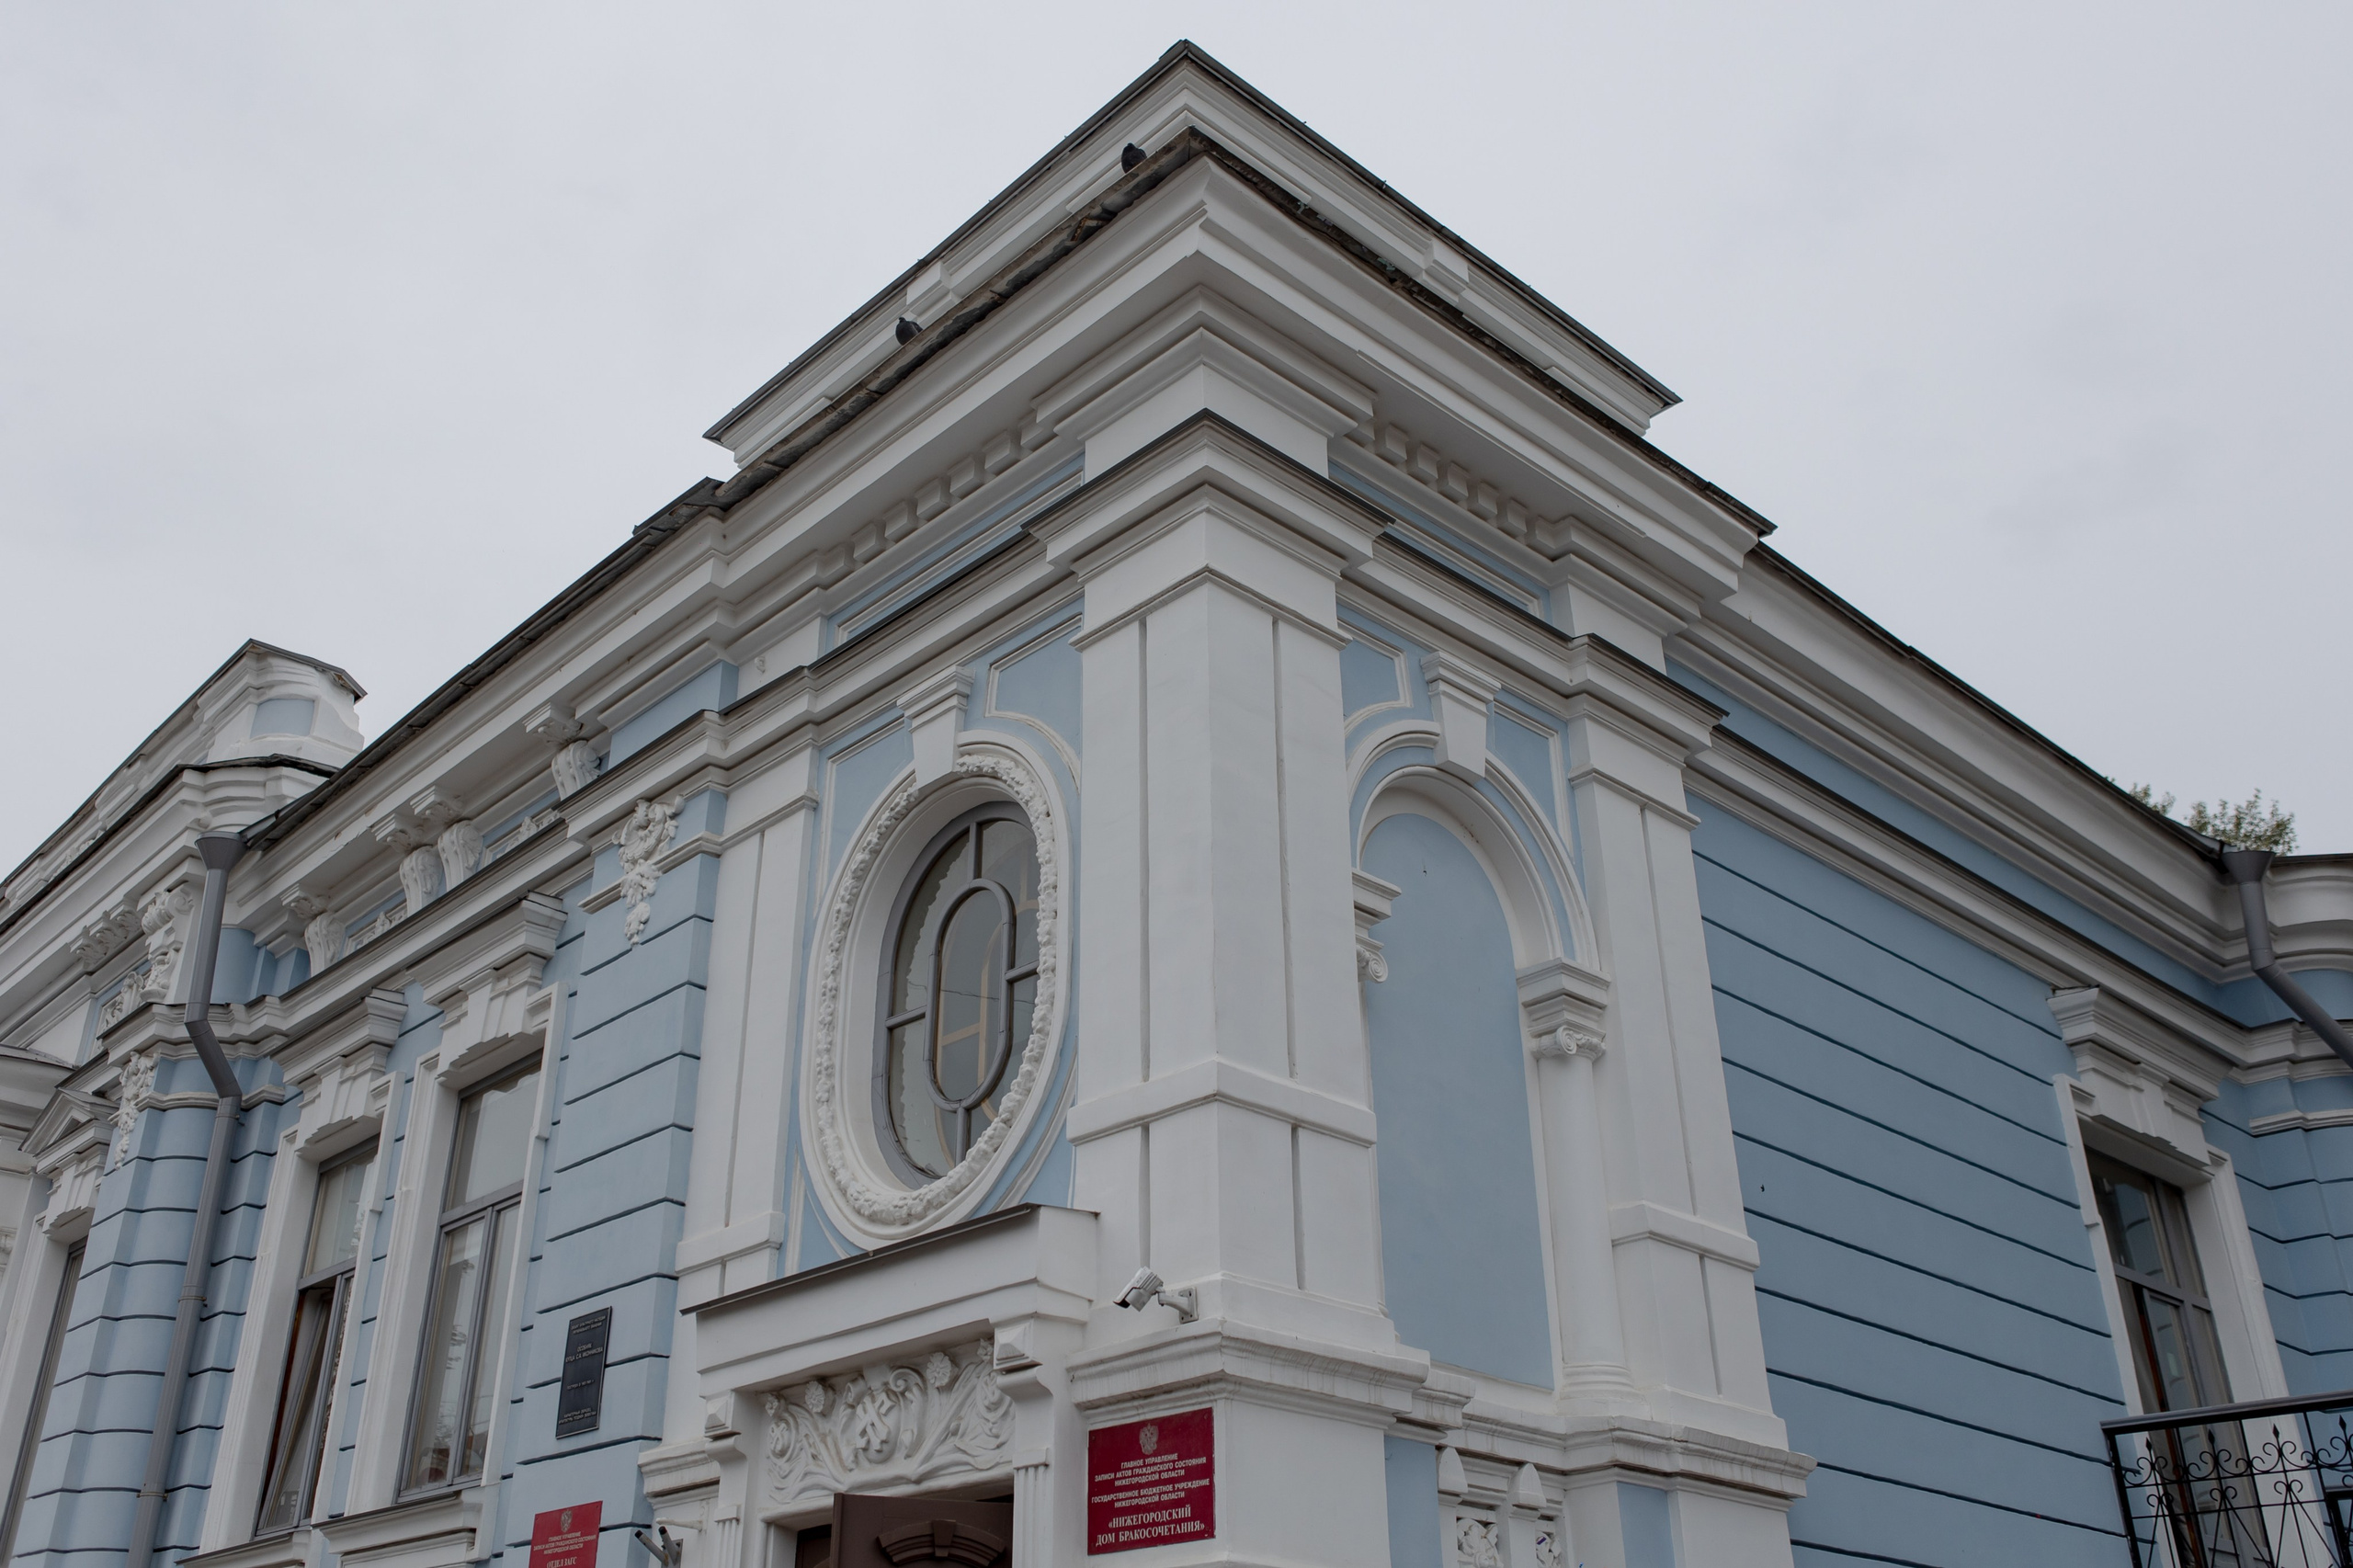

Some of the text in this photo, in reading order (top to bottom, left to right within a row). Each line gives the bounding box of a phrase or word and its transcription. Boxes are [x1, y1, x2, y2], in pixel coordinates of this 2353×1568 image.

[1095, 1457, 1206, 1482] ЗАПИСИ АКТОВ ГРАЖДАНСКОГО СОСТОЯНИЯ
[1121, 1453, 1178, 1469] ГЛАВНОЕ УПРАВЛЕНИЕ
[1115, 1470, 1185, 1486] НИЖЕГОРОДСКОЙ ОБЛАСТИ
[1092, 1479, 1210, 1504] ГОСУДАРСТВЕННОЕ БЮДЖЕТНОЕ УЧРЕЖДЕНИЕ
[1115, 1492, 1185, 1507] НИЖЕГОРОДСКОЙ ОБЛАСТИ
[1108, 1505, 1191, 1528] «НИЖЕГОРОДСКИЙ
[1096, 1520, 1205, 1547] ДОМ БРАКОСОЧЕТАНИЯ»
[547, 1557, 577, 1568] ОТДЕЛ ЗАГС
